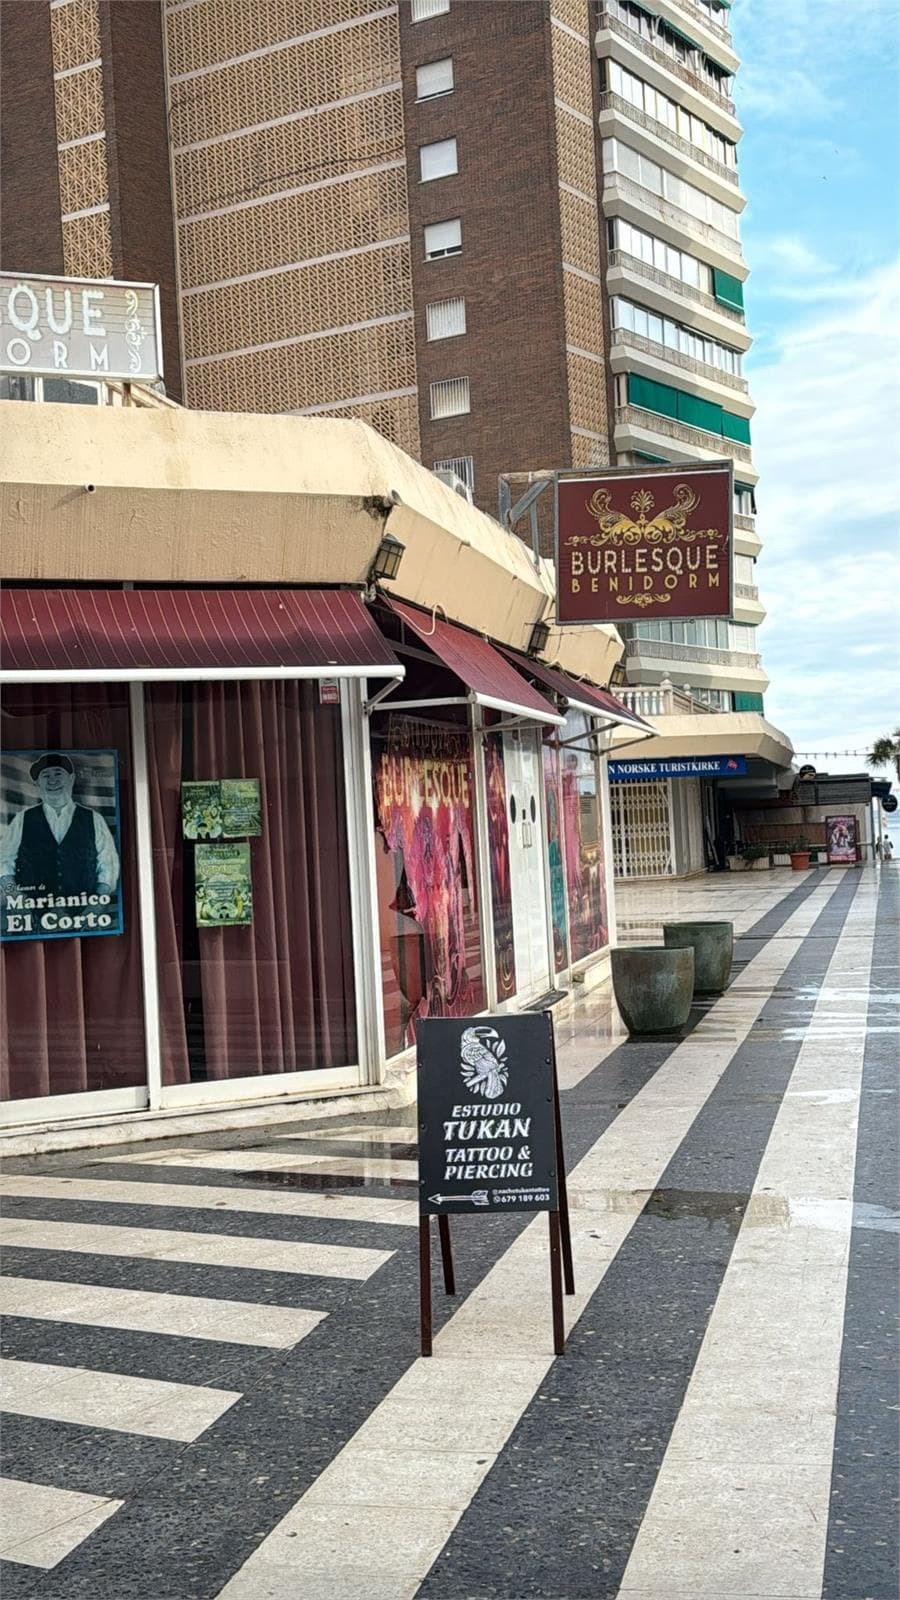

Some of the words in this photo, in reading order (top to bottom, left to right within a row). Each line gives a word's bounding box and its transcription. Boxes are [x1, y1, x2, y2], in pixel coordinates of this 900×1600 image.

[0, 283, 107, 341] QUE
[571, 545, 719, 575] BURLESQUE
[571, 573, 720, 593] BENIDORM
[618, 763, 657, 774] NORSKE
[660, 761, 720, 773] TURISTKIRKE
[6, 892, 111, 910] Marianico
[6, 914, 33, 932] El
[40, 912, 112, 930] Corto
[451, 1102, 521, 1118] ESTUDIO
[443, 1117, 531, 1141] TUKAN
[445, 1146, 514, 1163] TATTOO
[517, 1145, 531, 1160] &
[443, 1162, 533, 1180] PIERCING
[501, 1195, 517, 1203] 679
[518, 1194, 534, 1202] 189
[534, 1193, 550, 1202] 603
